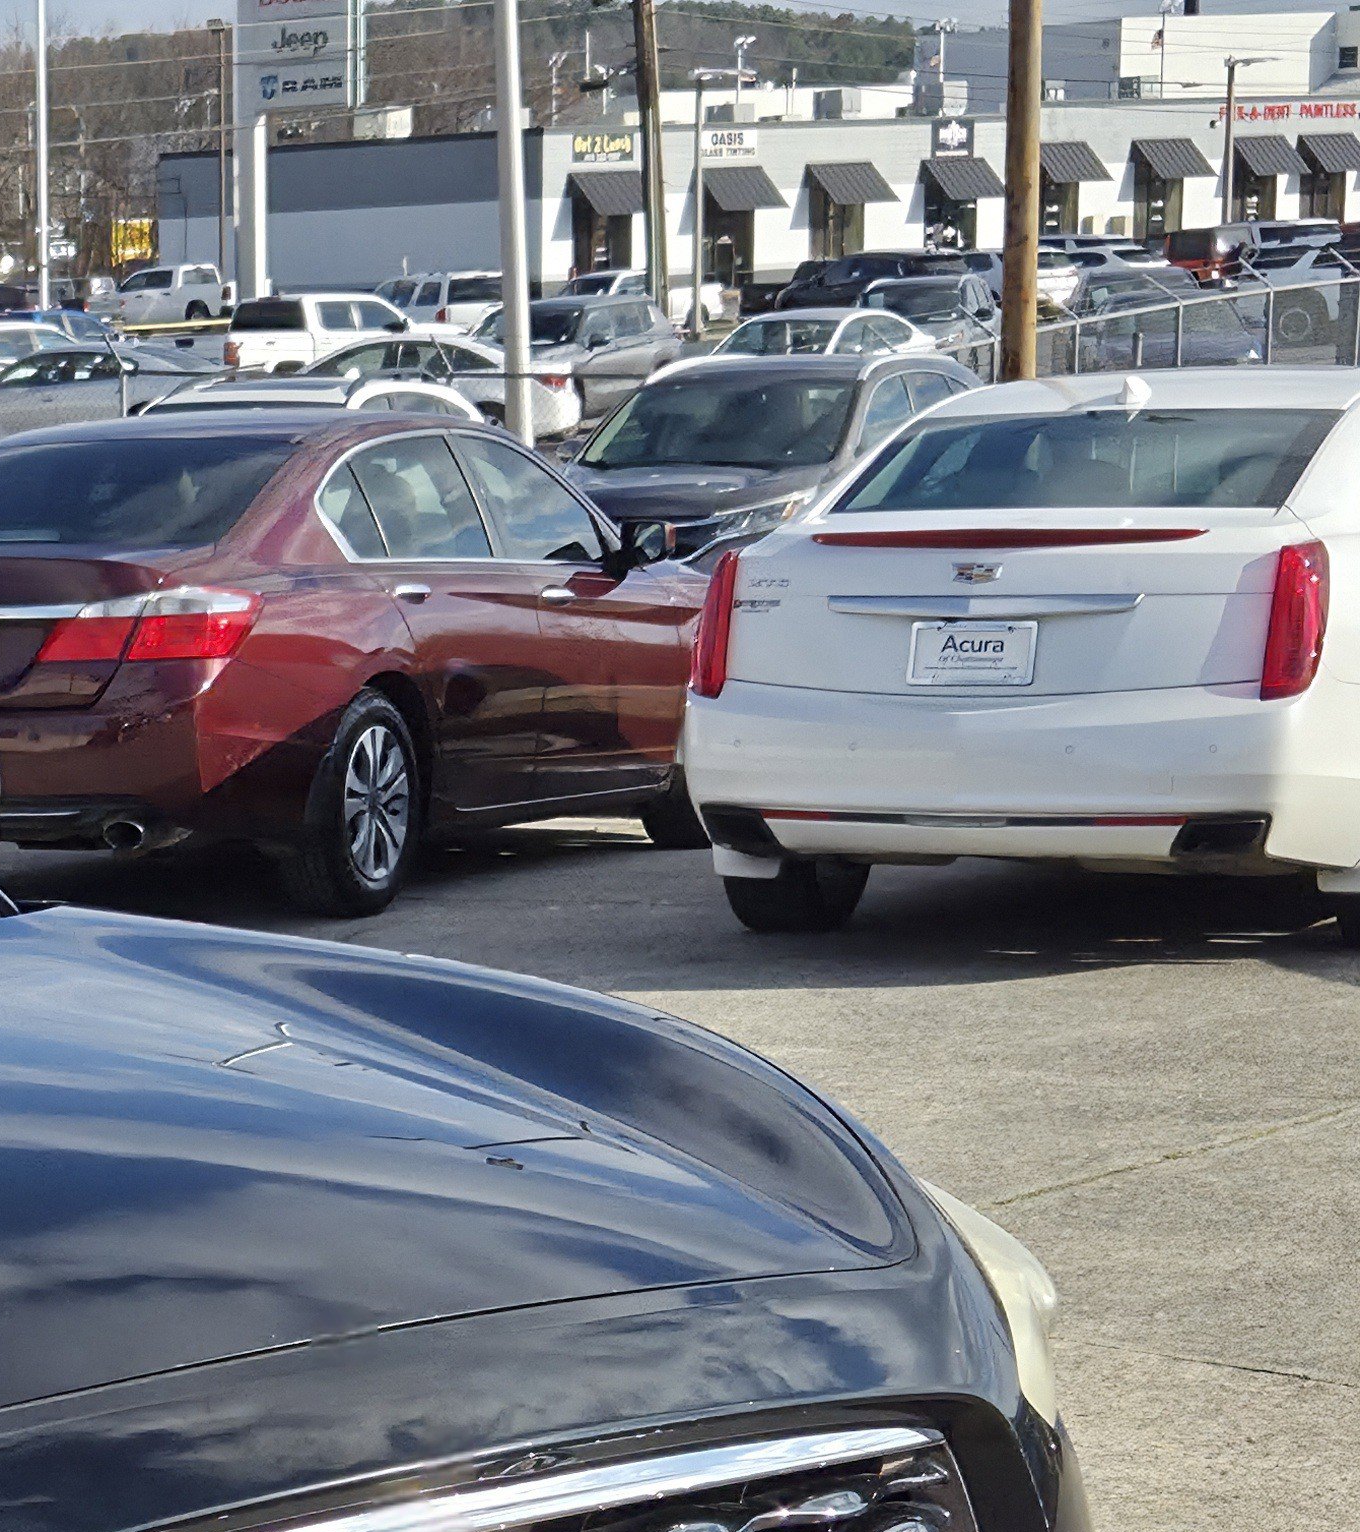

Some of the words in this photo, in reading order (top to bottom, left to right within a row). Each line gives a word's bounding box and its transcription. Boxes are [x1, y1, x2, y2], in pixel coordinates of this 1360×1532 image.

[271, 24, 328, 57] Jeep
[282, 76, 342, 92] RAM
[711, 132, 744, 146] OASIS
[941, 635, 1005, 653] Acura
